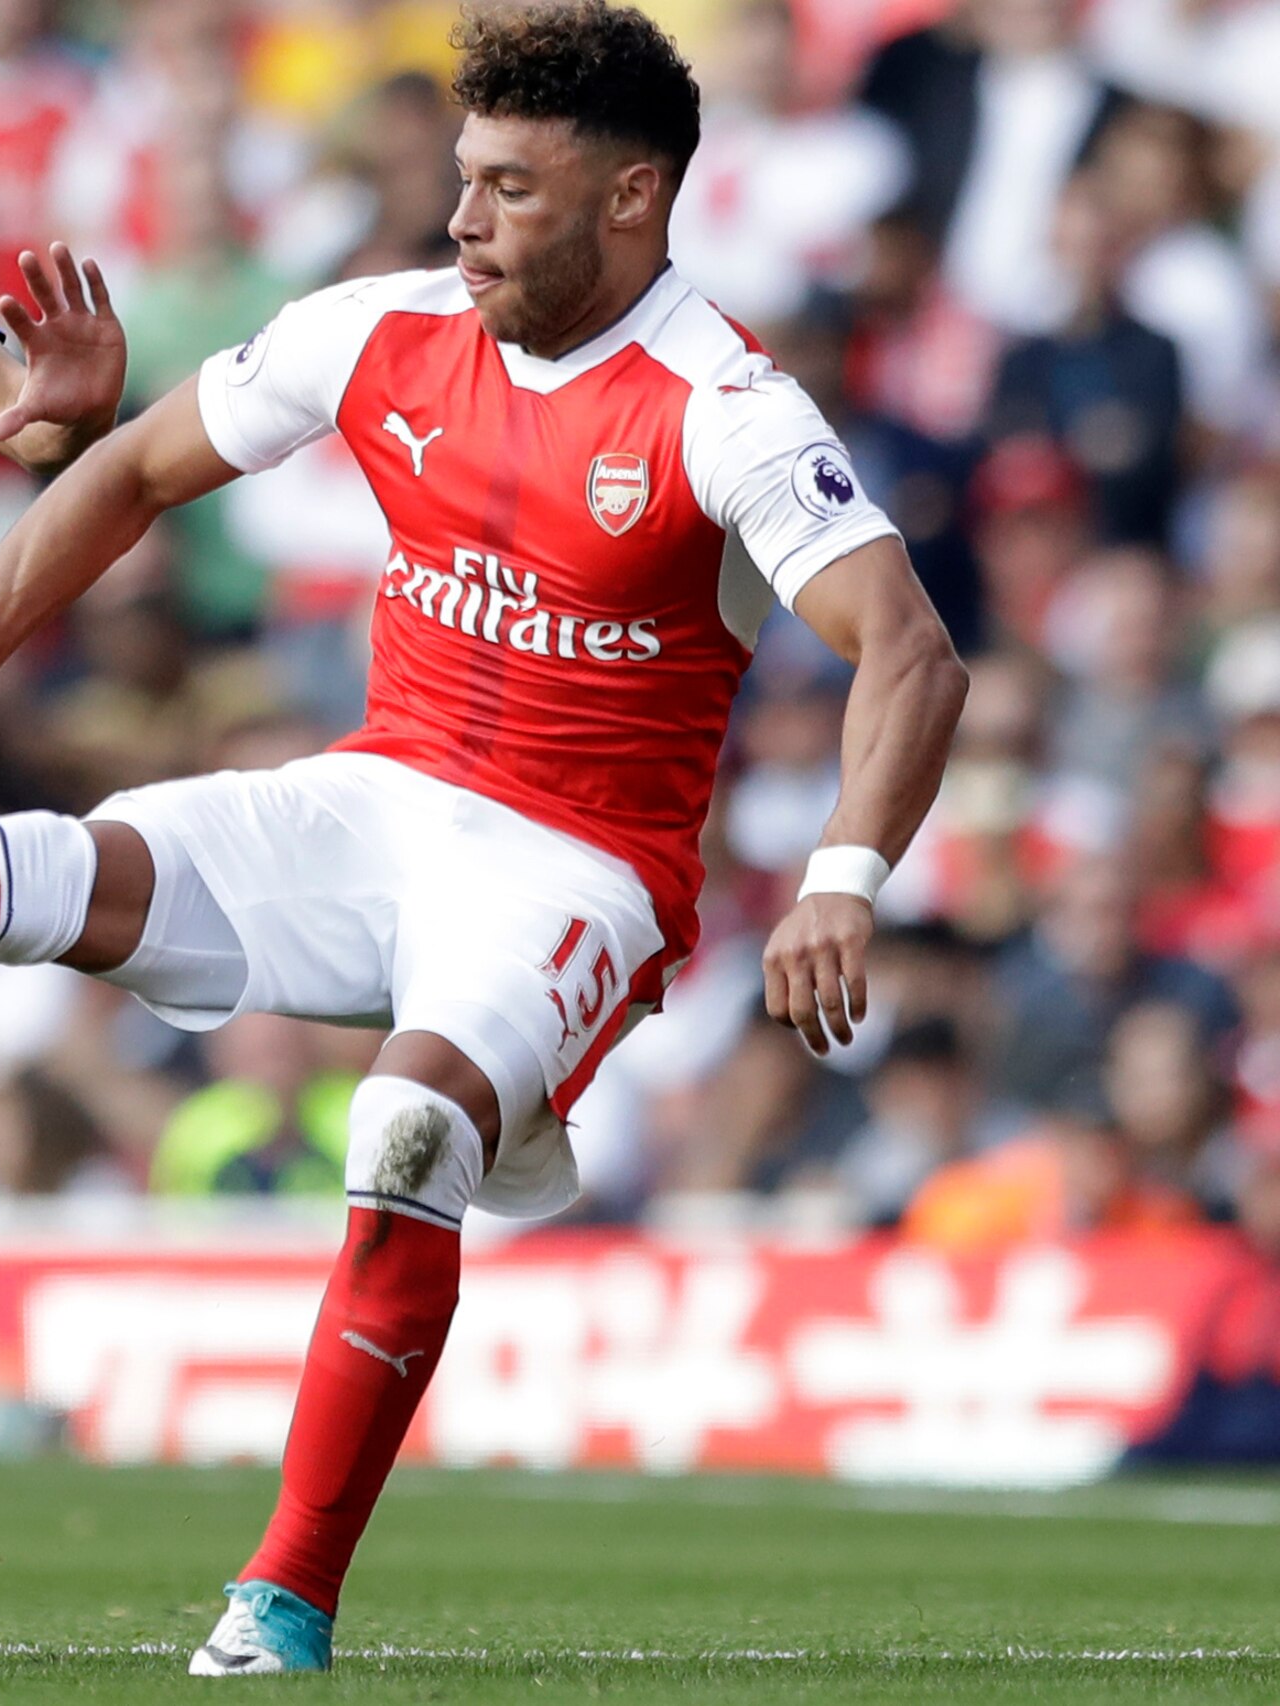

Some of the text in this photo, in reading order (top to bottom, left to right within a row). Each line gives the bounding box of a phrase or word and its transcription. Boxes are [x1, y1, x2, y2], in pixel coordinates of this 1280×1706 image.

[597, 464, 642, 481] Arsenal
[453, 546, 538, 613] Fly
[538, 917, 619, 1031] 15
